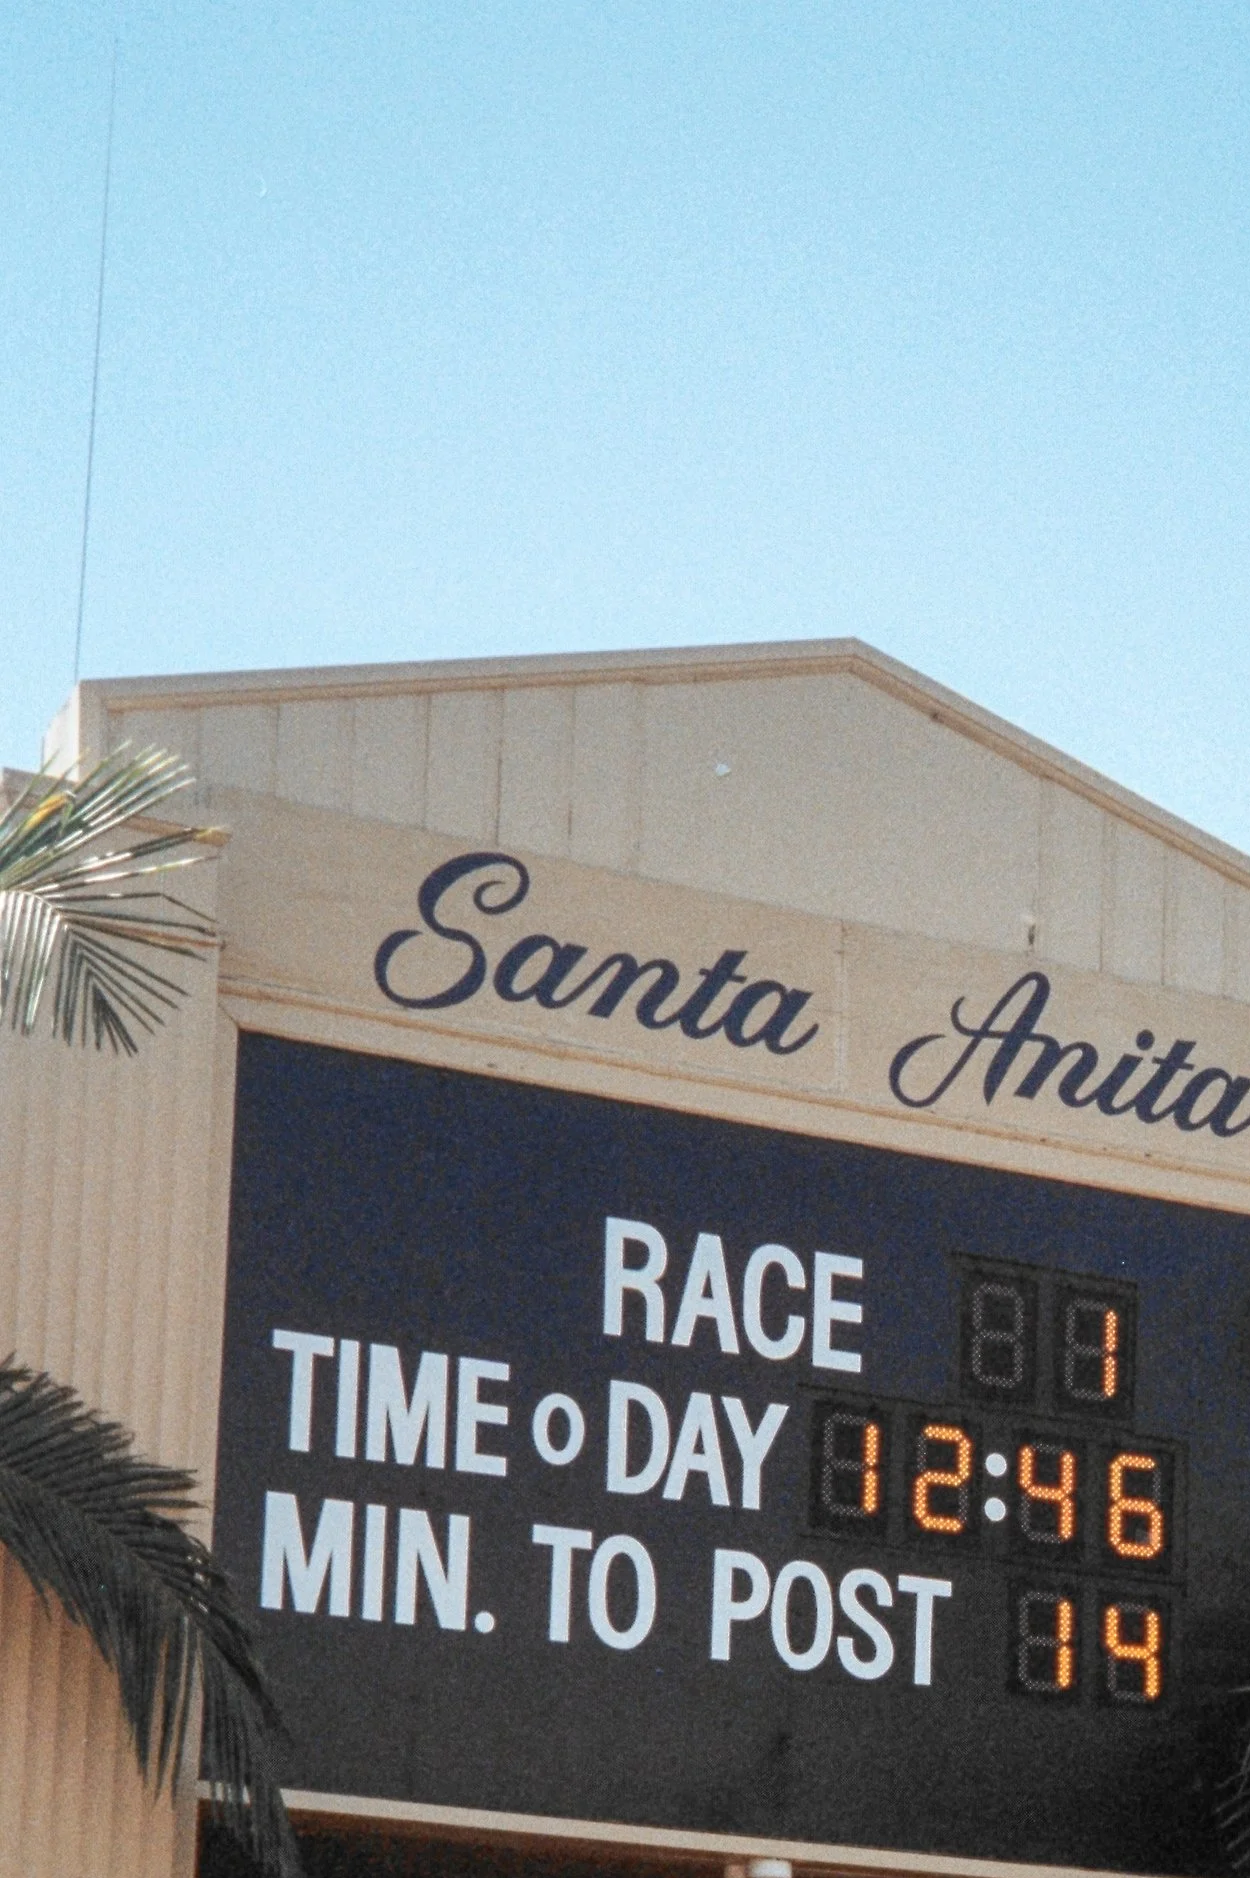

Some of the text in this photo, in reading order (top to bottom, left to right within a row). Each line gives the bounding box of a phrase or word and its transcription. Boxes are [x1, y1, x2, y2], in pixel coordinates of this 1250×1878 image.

[373, 852, 819, 1055] Santa
[603, 1216, 864, 1374] RACE
[1101, 1309, 1118, 1397] 1
[272, 1329, 511, 1477] TIME
[606, 1379, 790, 1511] DAY
[862, 1423, 1163, 1559] 12:46
[260, 1490, 953, 1686] MIN. TO POST
[1056, 1600, 1161, 1699] 14
